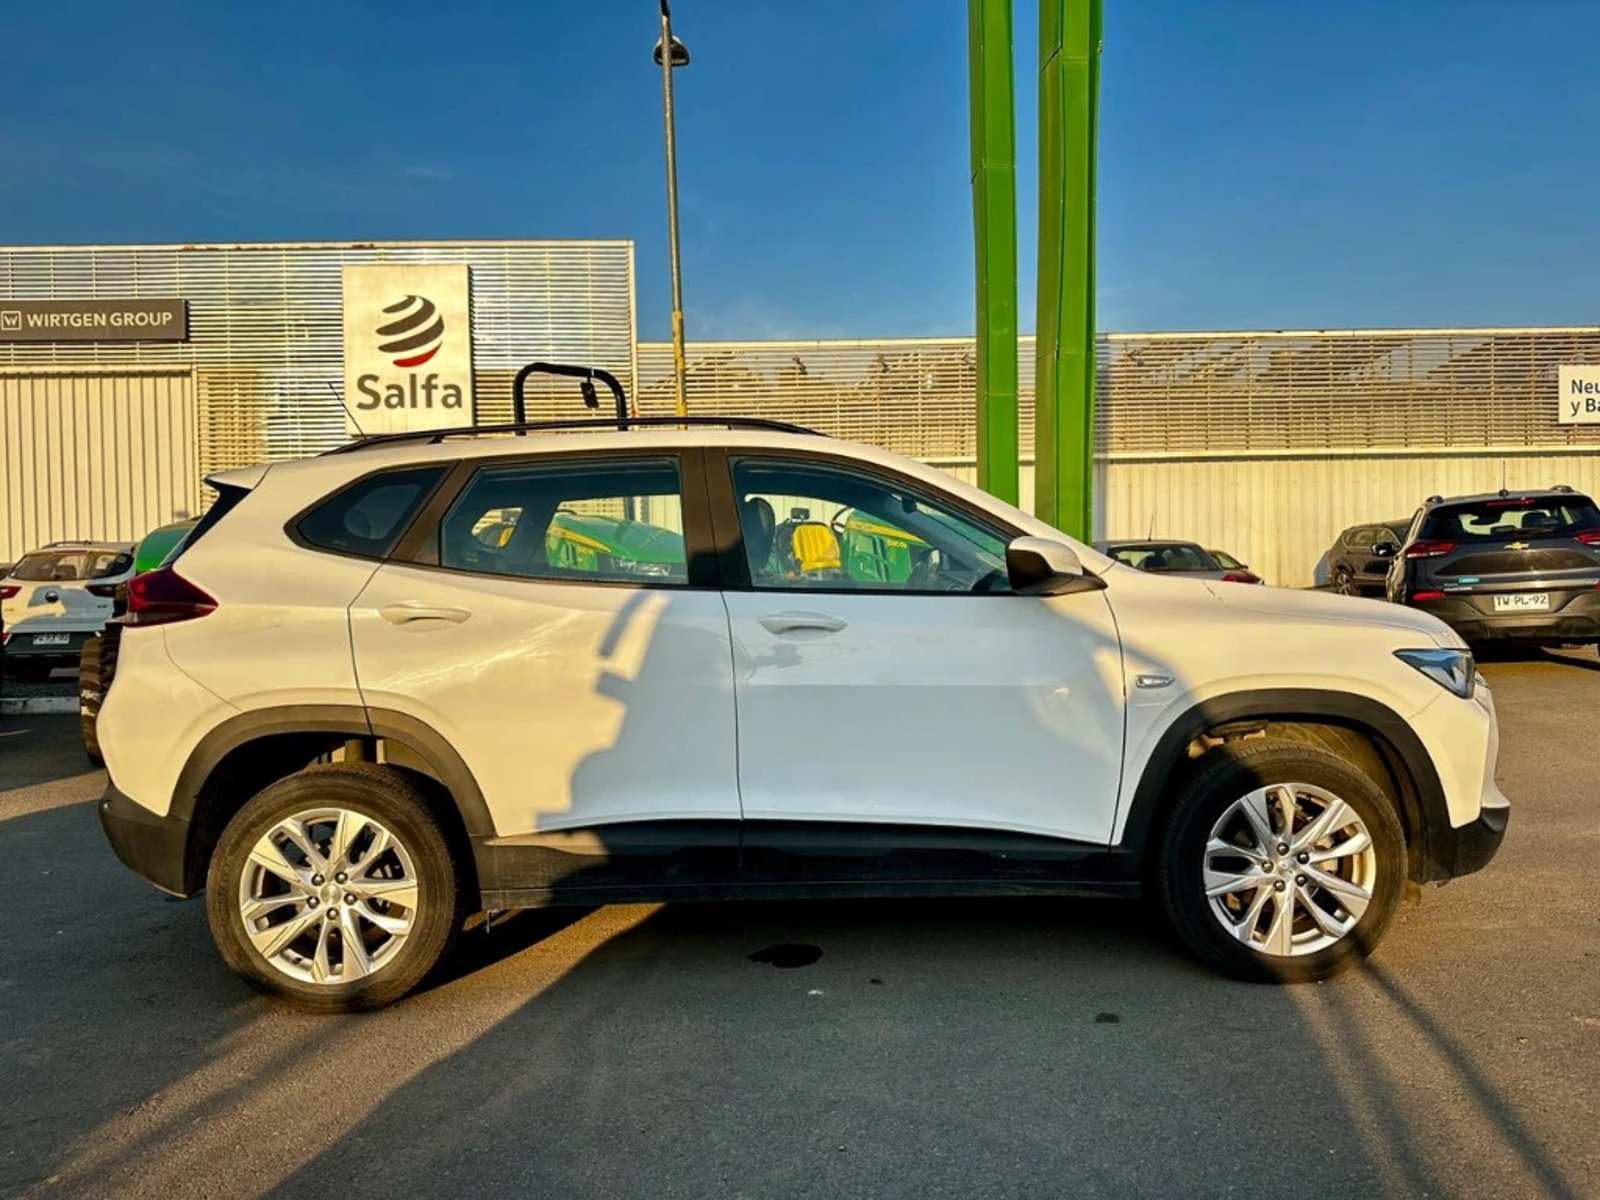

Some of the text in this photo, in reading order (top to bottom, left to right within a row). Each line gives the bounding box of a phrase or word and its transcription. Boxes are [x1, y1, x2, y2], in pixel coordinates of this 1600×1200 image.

[27, 313, 107, 327] WIRTGEN
[110, 312, 173, 326] GROUP
[356, 373, 463, 410] Salfa
[1571, 401, 1580, 417] y
